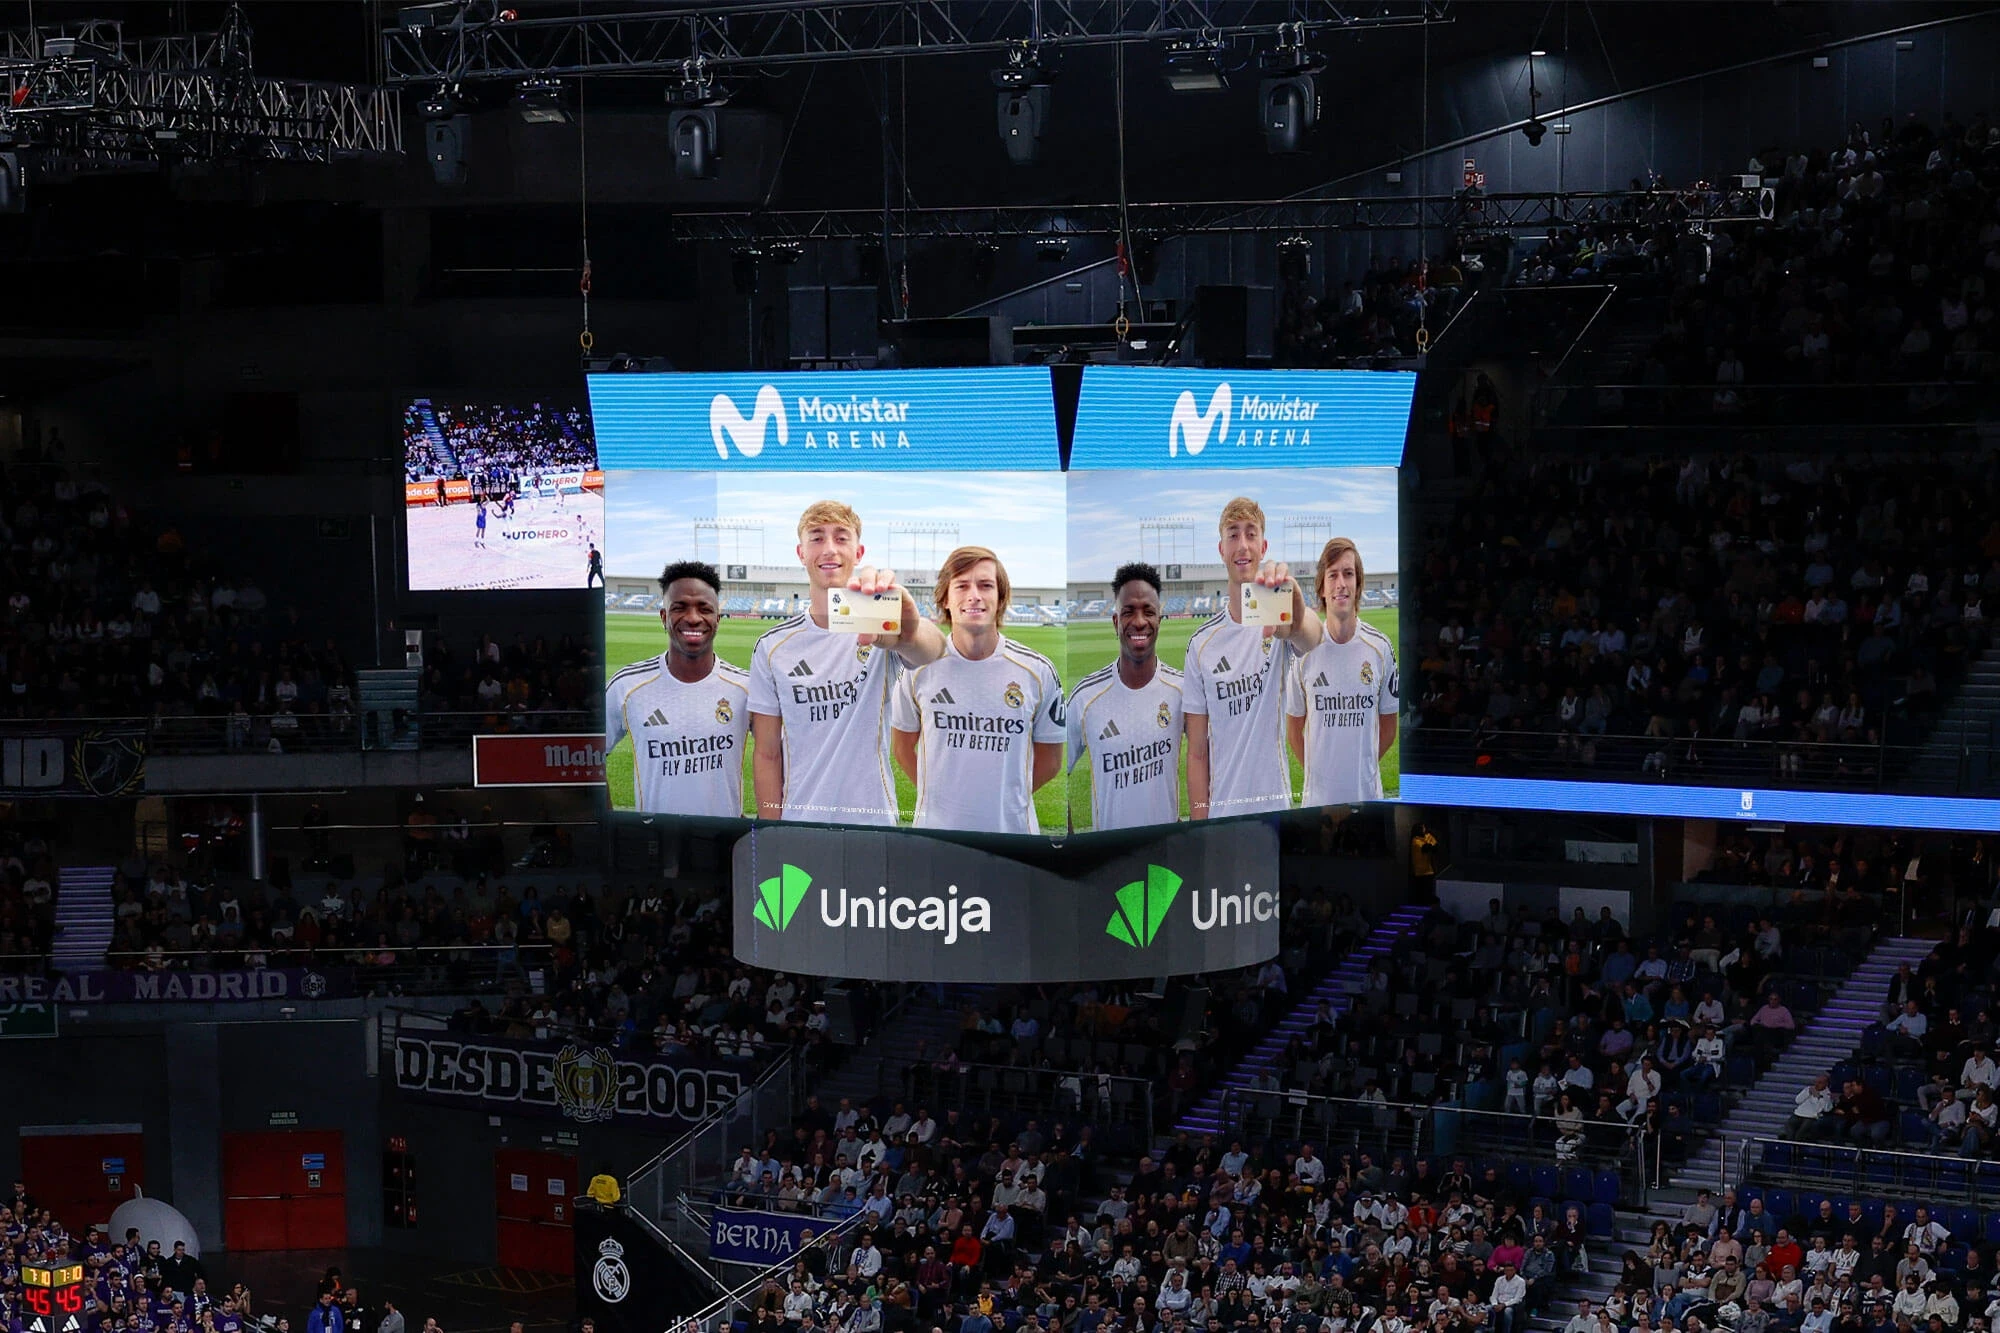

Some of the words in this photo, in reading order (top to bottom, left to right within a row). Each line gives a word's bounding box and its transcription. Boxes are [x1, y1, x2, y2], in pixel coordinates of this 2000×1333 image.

[798, 394, 910, 423] Movistar
[1239, 393, 1320, 422] Movistar
[805, 430, 911, 449] ARENA
[1236, 428, 1311, 447] ARENA
[810, 705, 828, 722] FLY
[1228, 698, 1242, 717] FLY
[1315, 692, 1374, 711] Emirates
[934, 707, 1025, 735] Emirates
[648, 733, 734, 759] Emirates
[947, 732, 964, 749] FLY
[969, 736, 1011, 753] BETTER
[1103, 738, 1172, 774] Emirates
[662, 760, 680, 776] FLY
[684, 754, 723, 774] BETTER
[1115, 772, 1129, 790] FLY
[1133, 759, 1164, 785] BETTER
[820, 884, 991, 945] Unicaja
[0, 974, 104, 1001] REAL
[134, 971, 288, 1000] MADRID
[394, 1037, 558, 1106] DESDE
[60, 1264, 83, 1283] 7:10
[26, 1288, 51, 1315] 45
[56, 1284, 82, 1312] 45
